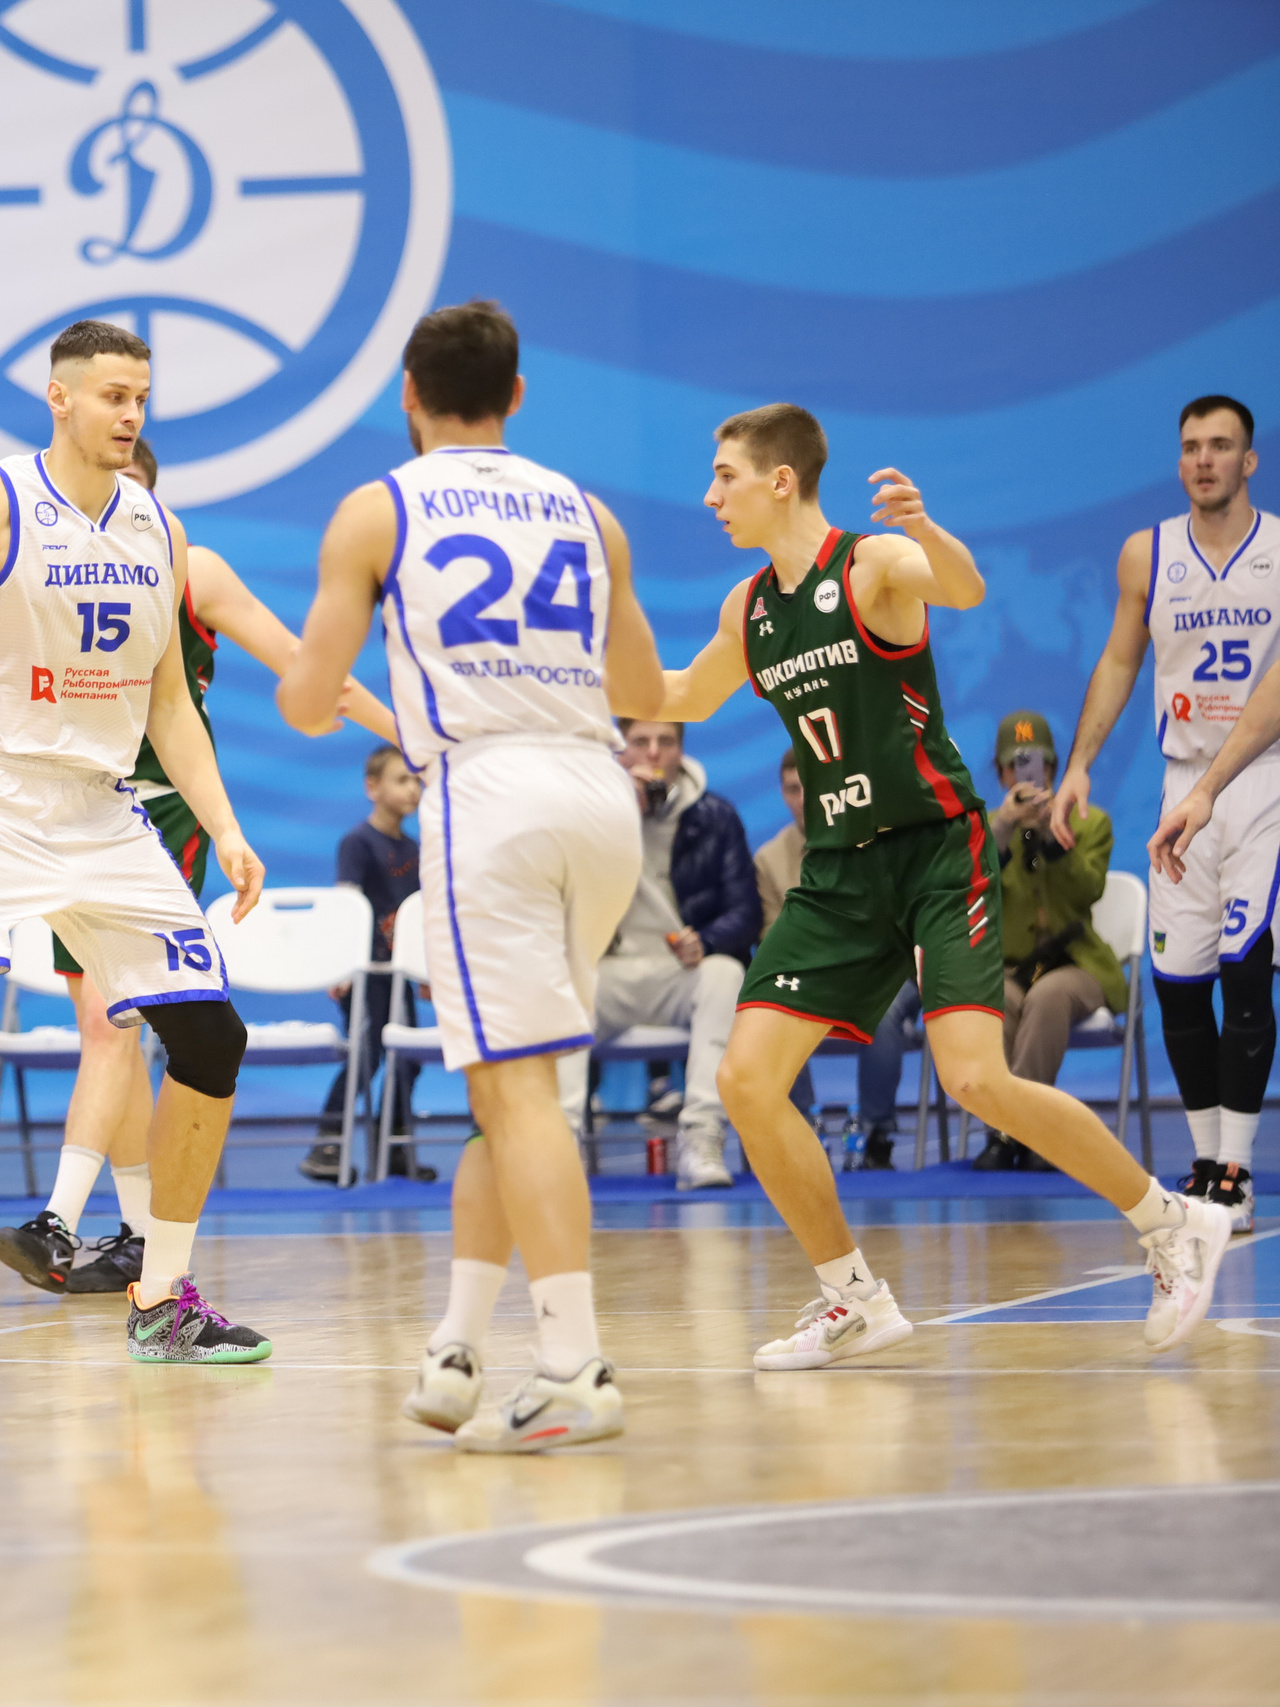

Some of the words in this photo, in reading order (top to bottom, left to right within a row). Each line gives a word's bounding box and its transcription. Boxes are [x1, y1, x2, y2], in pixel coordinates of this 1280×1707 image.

[419, 488, 581, 524] КОРЧАГИН
[44, 562, 160, 588] ДИНАМО
[423, 533, 594, 655] 24
[818, 589, 838, 603] РФБ
[76, 601, 132, 653] 15
[1173, 607, 1272, 633] ДИНАМО
[64, 667, 110, 679] Русская
[1192, 639, 1252, 682] 25
[60, 690, 118, 701] Компания
[798, 707, 842, 763] 17
[1220, 898, 1249, 937] 5
[152, 928, 212, 972] 15
